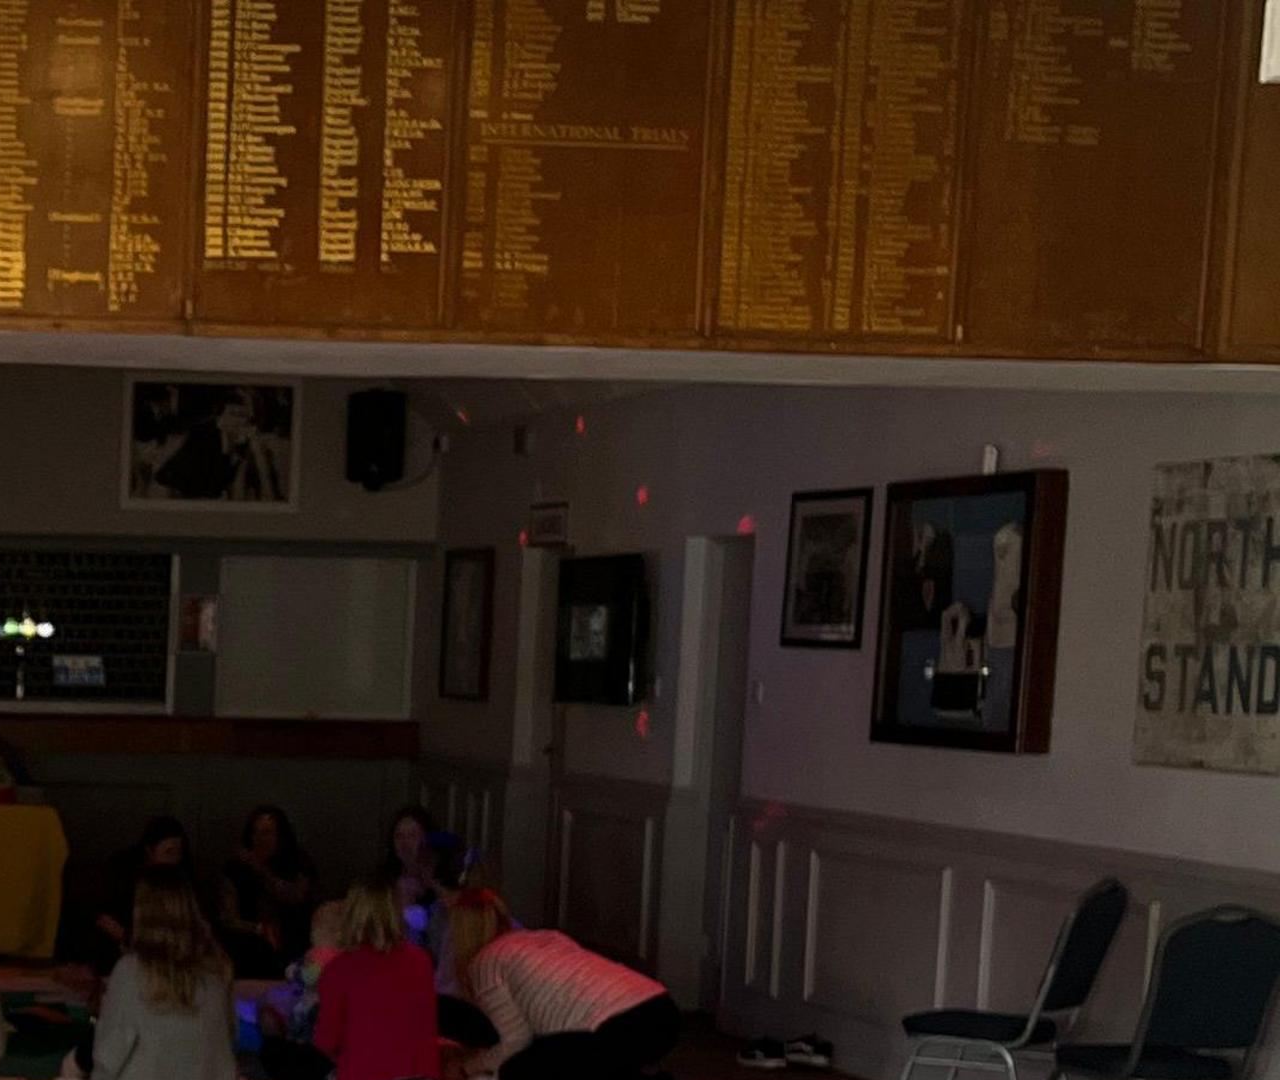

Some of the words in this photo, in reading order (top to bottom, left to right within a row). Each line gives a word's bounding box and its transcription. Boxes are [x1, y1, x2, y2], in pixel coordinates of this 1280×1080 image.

[481, 122, 624, 140] INTERNATIONAL
[1150, 516, 1280, 592] NORTH
[1143, 643, 1280, 715] STAND
